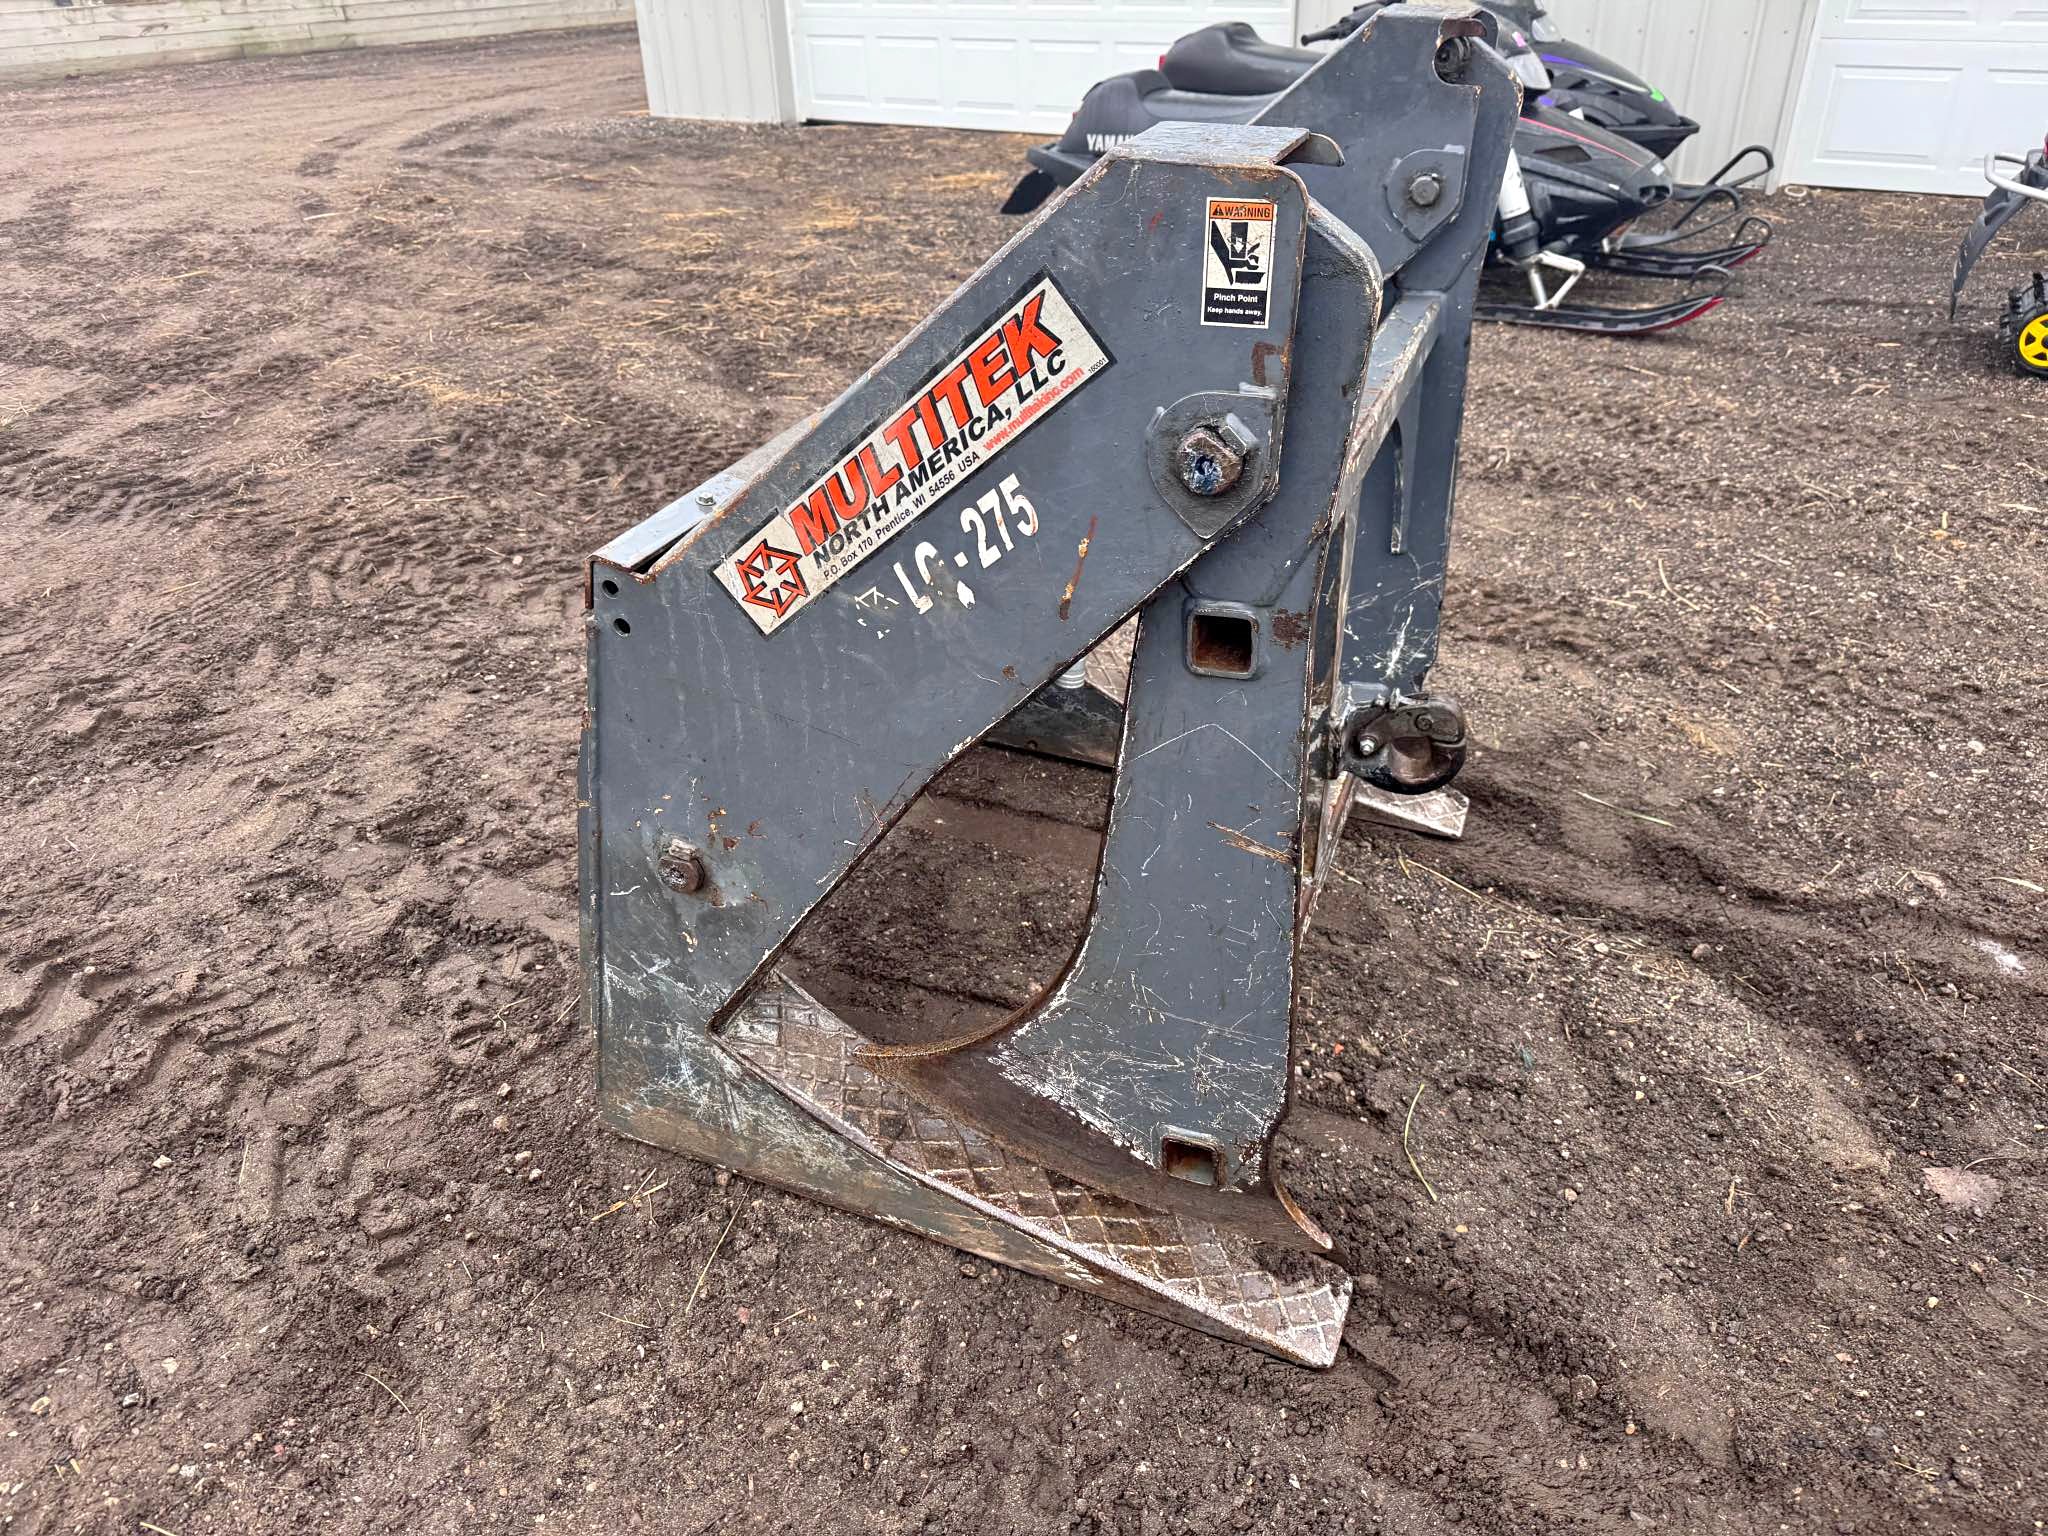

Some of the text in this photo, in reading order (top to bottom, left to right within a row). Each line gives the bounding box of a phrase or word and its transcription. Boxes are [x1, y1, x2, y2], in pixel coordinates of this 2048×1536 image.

[1224, 206, 1270, 218] WARNING
[1207, 306, 1223, 315] Keep
[1224, 307, 1244, 315] hands
[1213, 293, 1258, 303] Pinch Point
[788, 289, 1063, 556] MULTITEK
[812, 348, 1066, 569] NORTH AMERICA, LLC
[823, 564, 841, 580] P.O.
[840, 551, 858, 567] Box
[857, 537, 874, 554] 170
[875, 507, 914, 540] Prentice,
[912, 493, 927, 510] WI
[928, 469, 956, 498] 54556
[958, 450, 981, 473] USA
